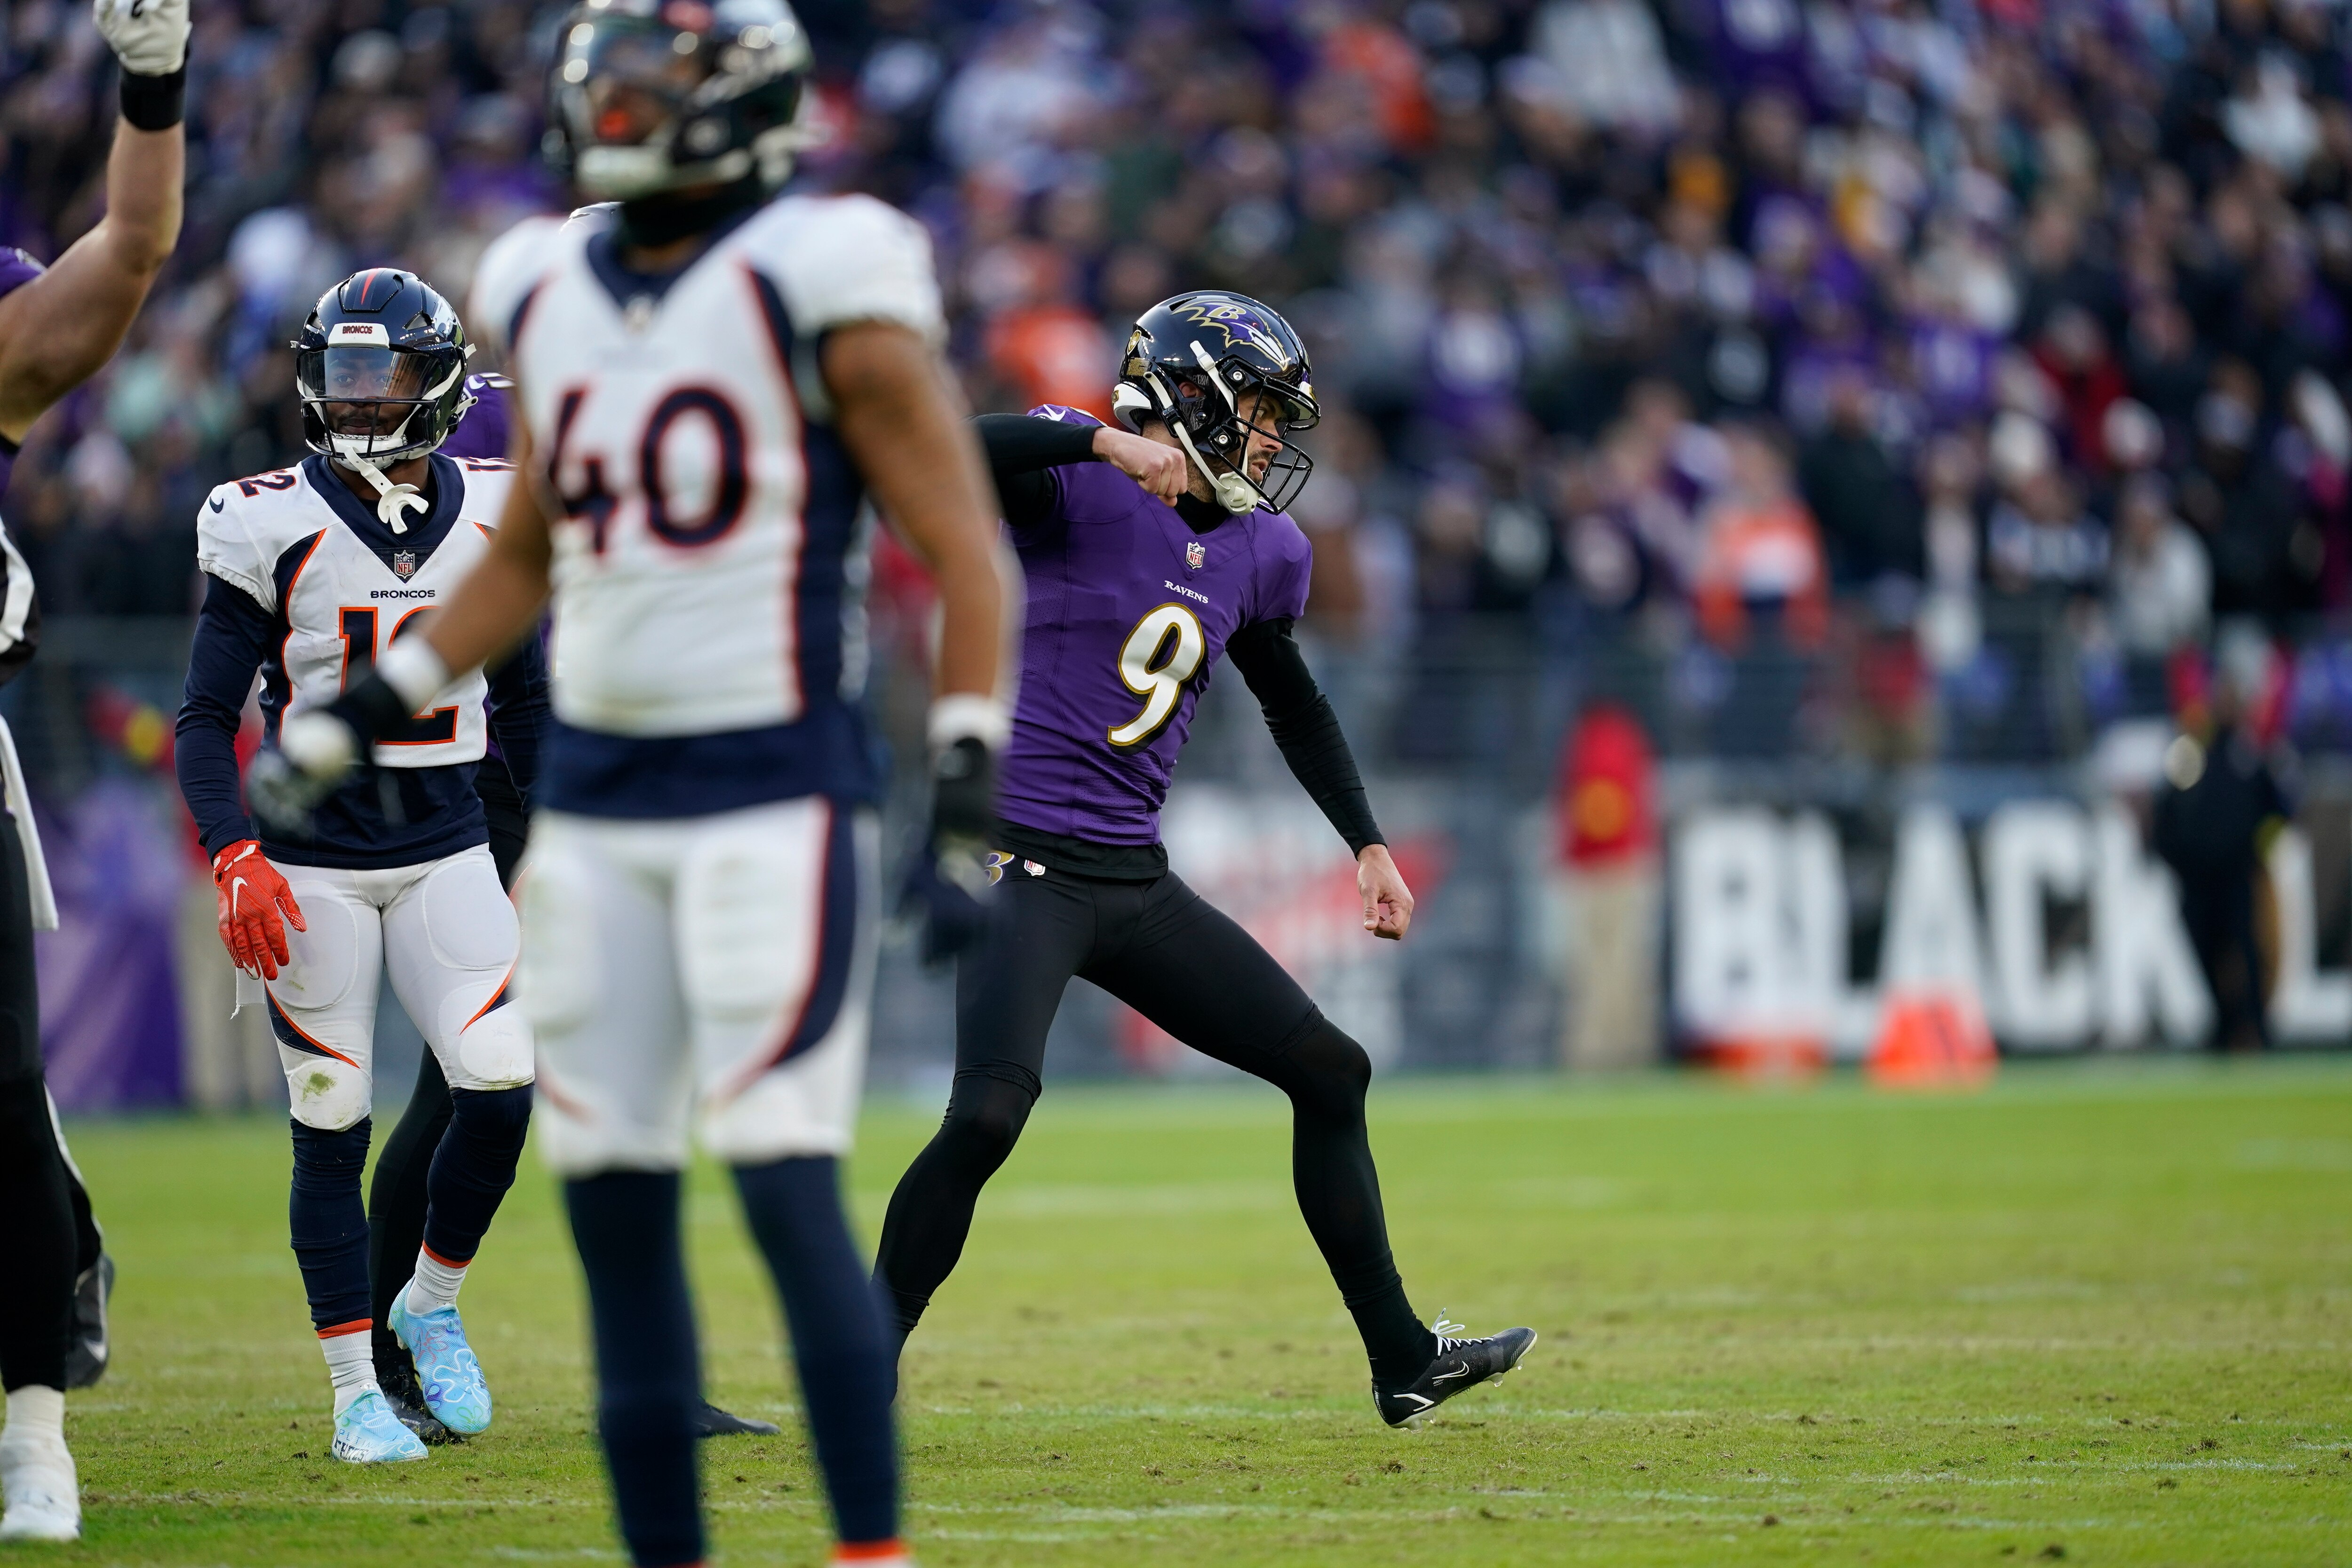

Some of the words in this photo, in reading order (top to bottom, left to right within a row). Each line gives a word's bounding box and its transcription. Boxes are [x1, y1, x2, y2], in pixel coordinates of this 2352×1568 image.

[548, 383, 749, 555] 40
[1189, 552, 1201, 564] NFL
[398, 563, 412, 573] NFL
[370, 590, 436, 598] BRONCOS
[1164, 580, 1208, 604] RAVENS
[1107, 602, 1205, 747] 9
